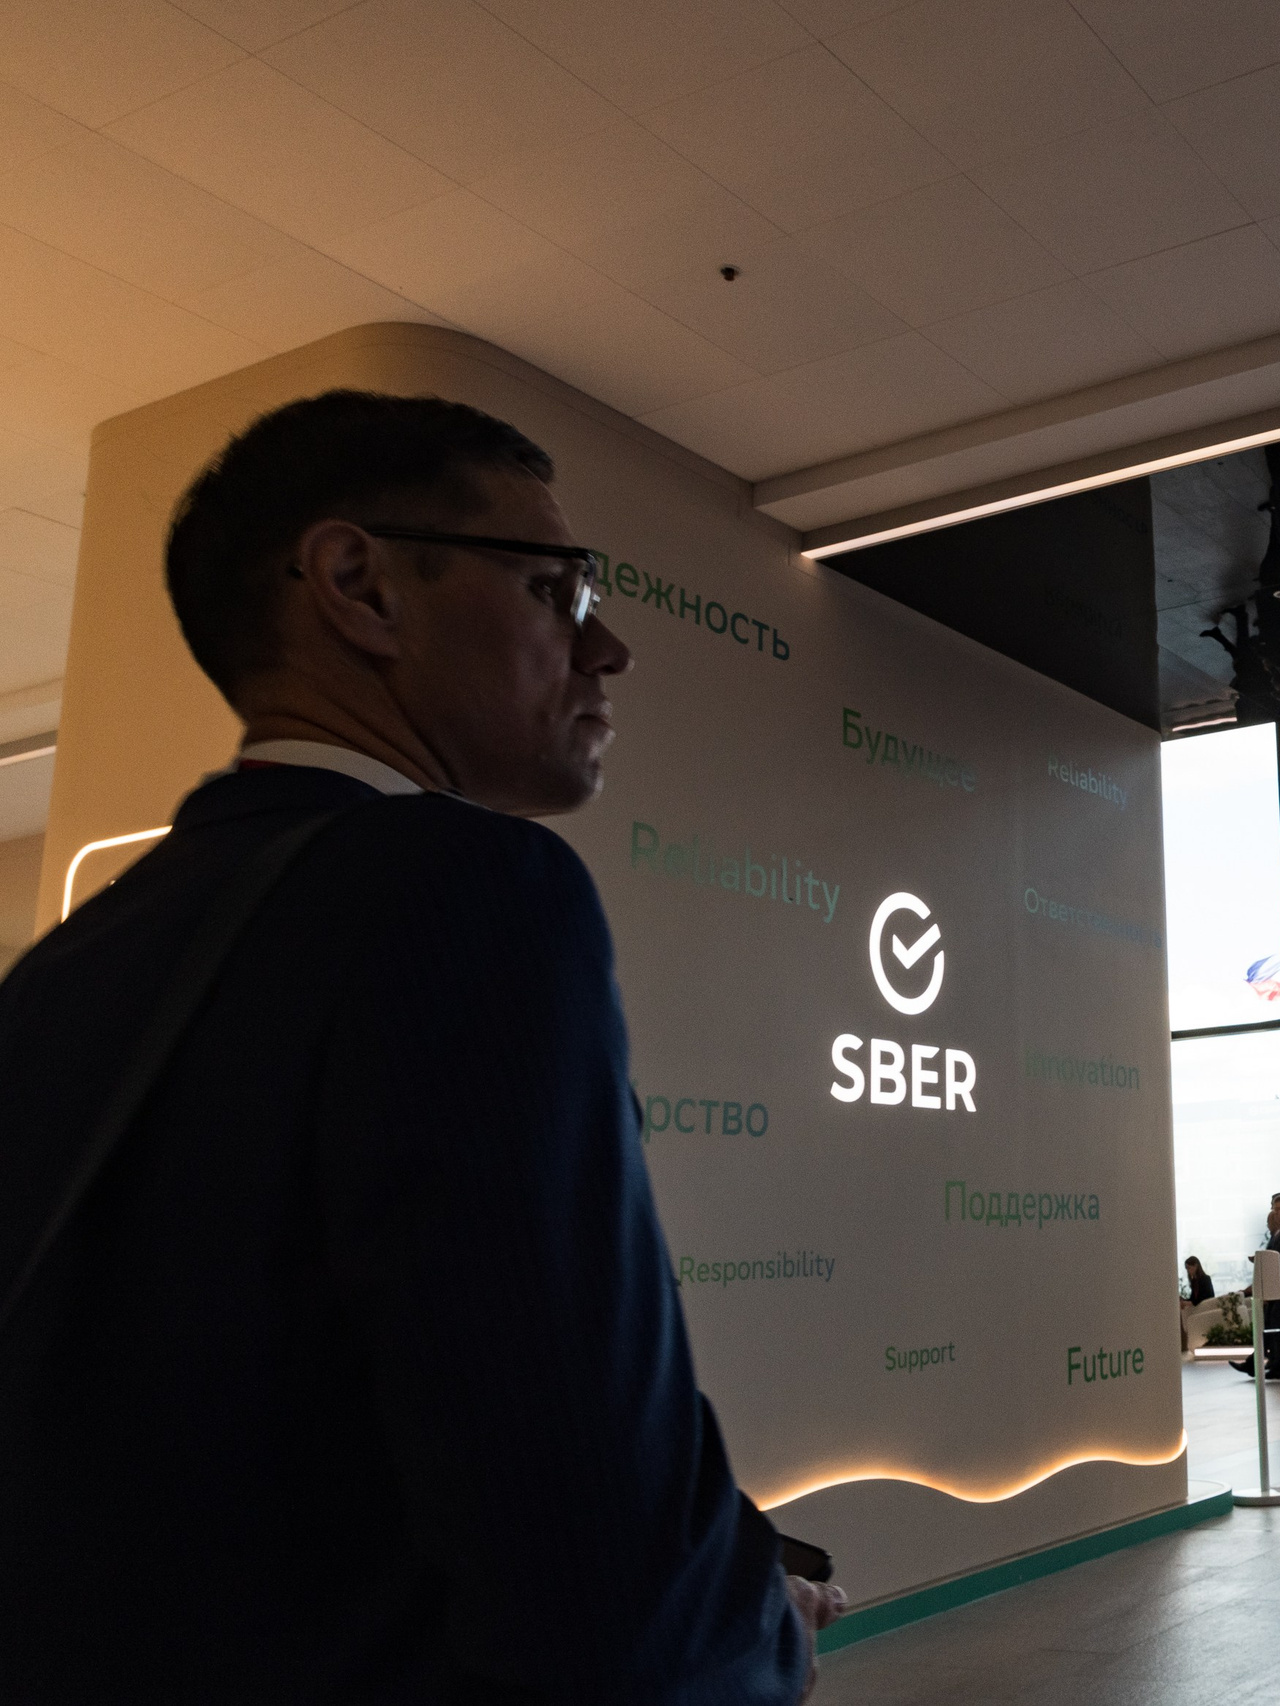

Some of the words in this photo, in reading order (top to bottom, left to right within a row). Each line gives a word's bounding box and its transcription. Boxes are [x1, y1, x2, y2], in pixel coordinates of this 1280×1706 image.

[595, 550, 790, 662] дежность
[841, 706, 978, 794] Будущее
[1047, 751, 1129, 812] Reliability
[630, 819, 841, 925] Reliability
[830, 1033, 977, 1113] SBER
[1023, 1043, 1141, 1091] Innovation
[640, 1093, 770, 1144] рство
[943, 1180, 1101, 1229] Поддержка
[680, 1251, 836, 1287] Responsibility
[885, 1342, 956, 1374] Support
[1067, 1344, 1145, 1387] Future
